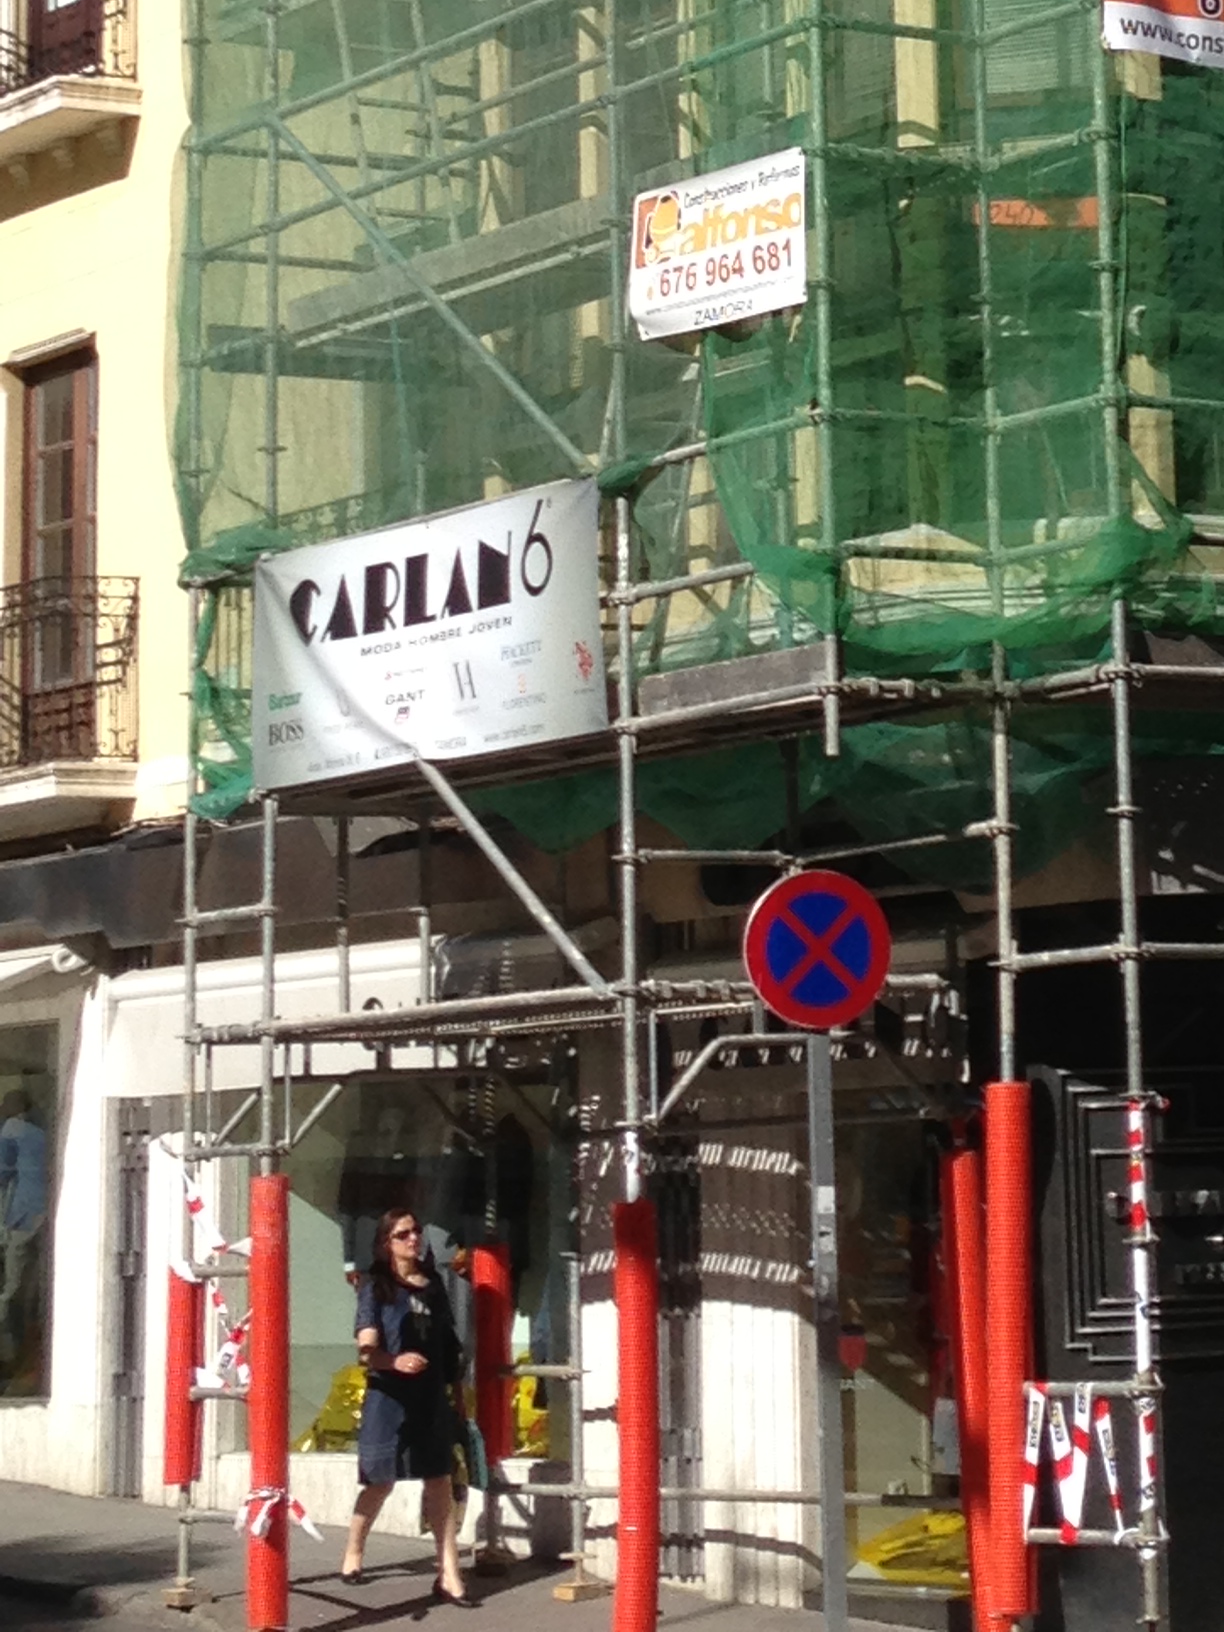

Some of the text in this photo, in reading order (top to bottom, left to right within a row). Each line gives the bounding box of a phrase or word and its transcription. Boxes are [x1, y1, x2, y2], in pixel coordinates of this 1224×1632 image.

[679, 192, 802, 256] alfonso
[660, 263, 697, 297] 676
[705, 250, 745, 287] 964
[752, 238, 792, 274] 681
[360, 642, 402, 656] MODA
[468, 616, 513, 635] JOVEN
[385, 689, 425, 706] GANT
[268, 718, 305, 746] BOSS
